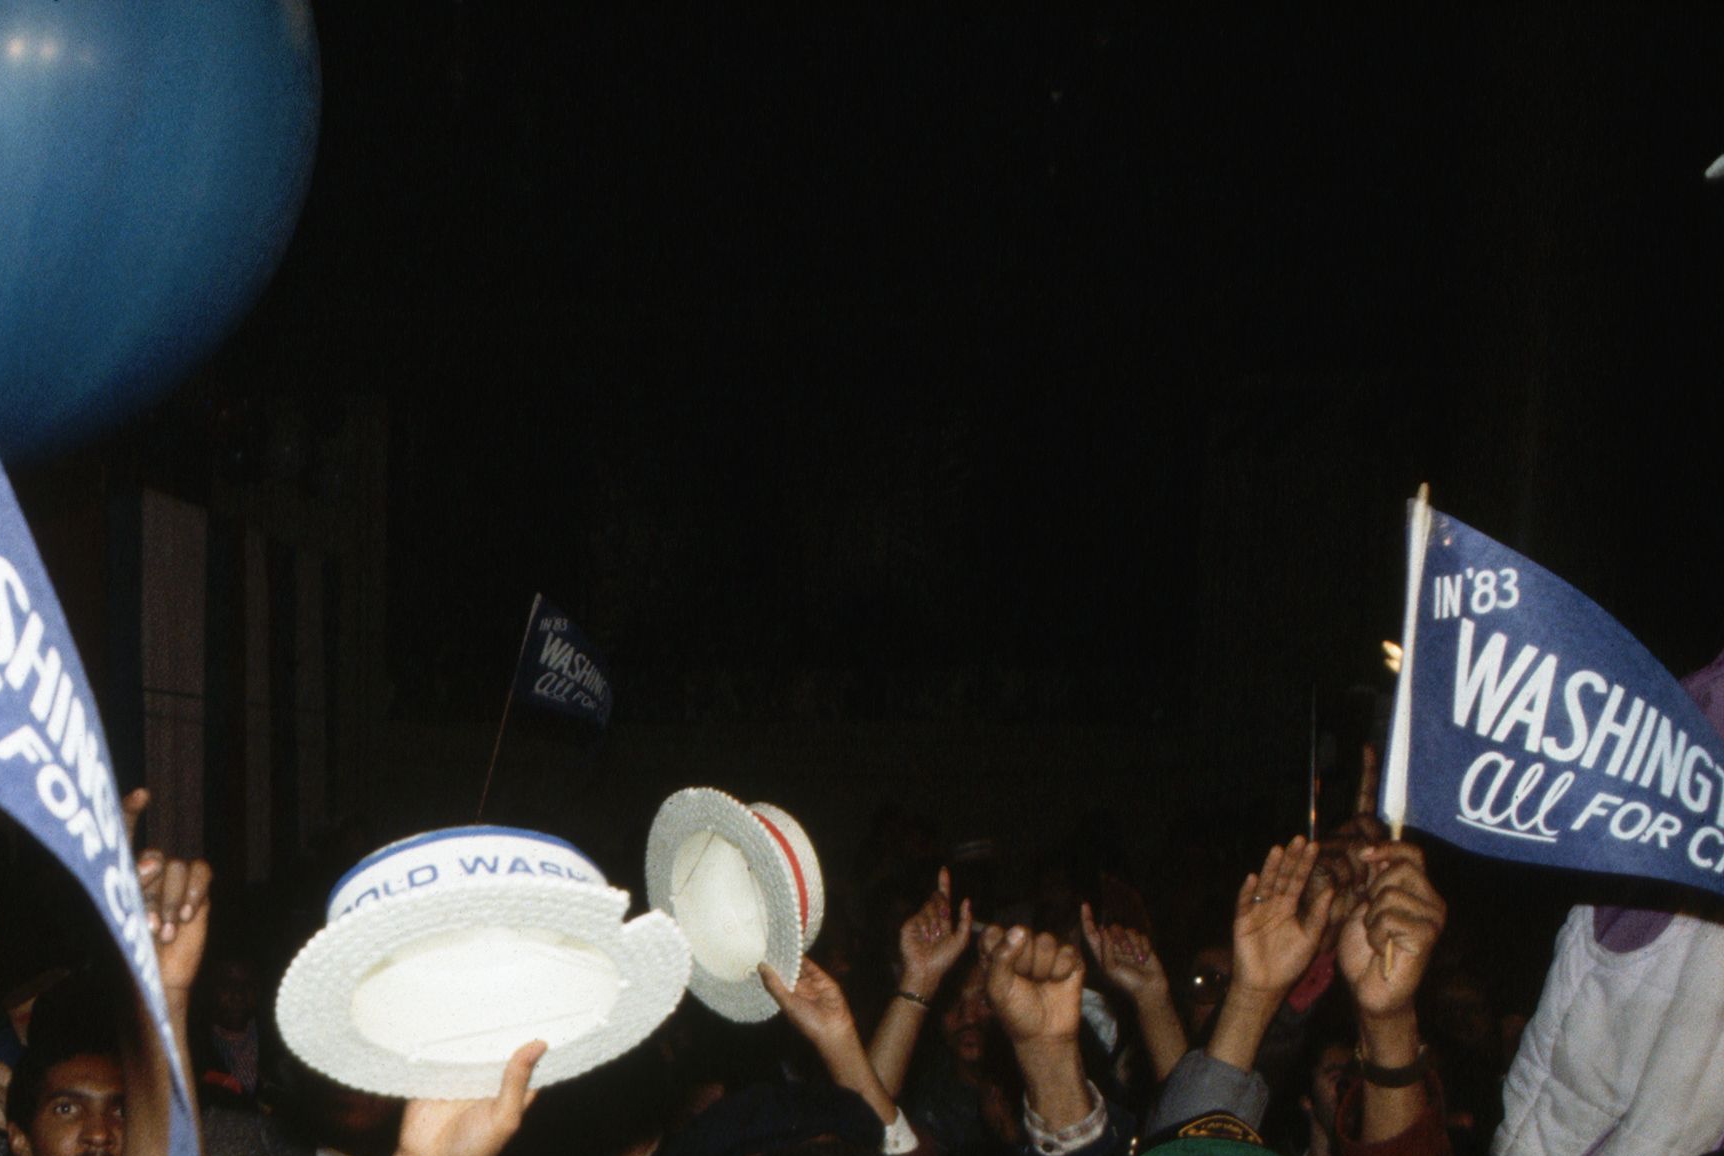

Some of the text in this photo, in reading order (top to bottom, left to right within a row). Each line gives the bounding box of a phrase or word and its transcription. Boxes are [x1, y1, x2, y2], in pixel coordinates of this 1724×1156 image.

[1433, 566, 1520, 620] IN '83
[1457, 751, 1575, 840] all
[1570, 792, 1683, 849] FOR
[342, 864, 439, 912] OLD
